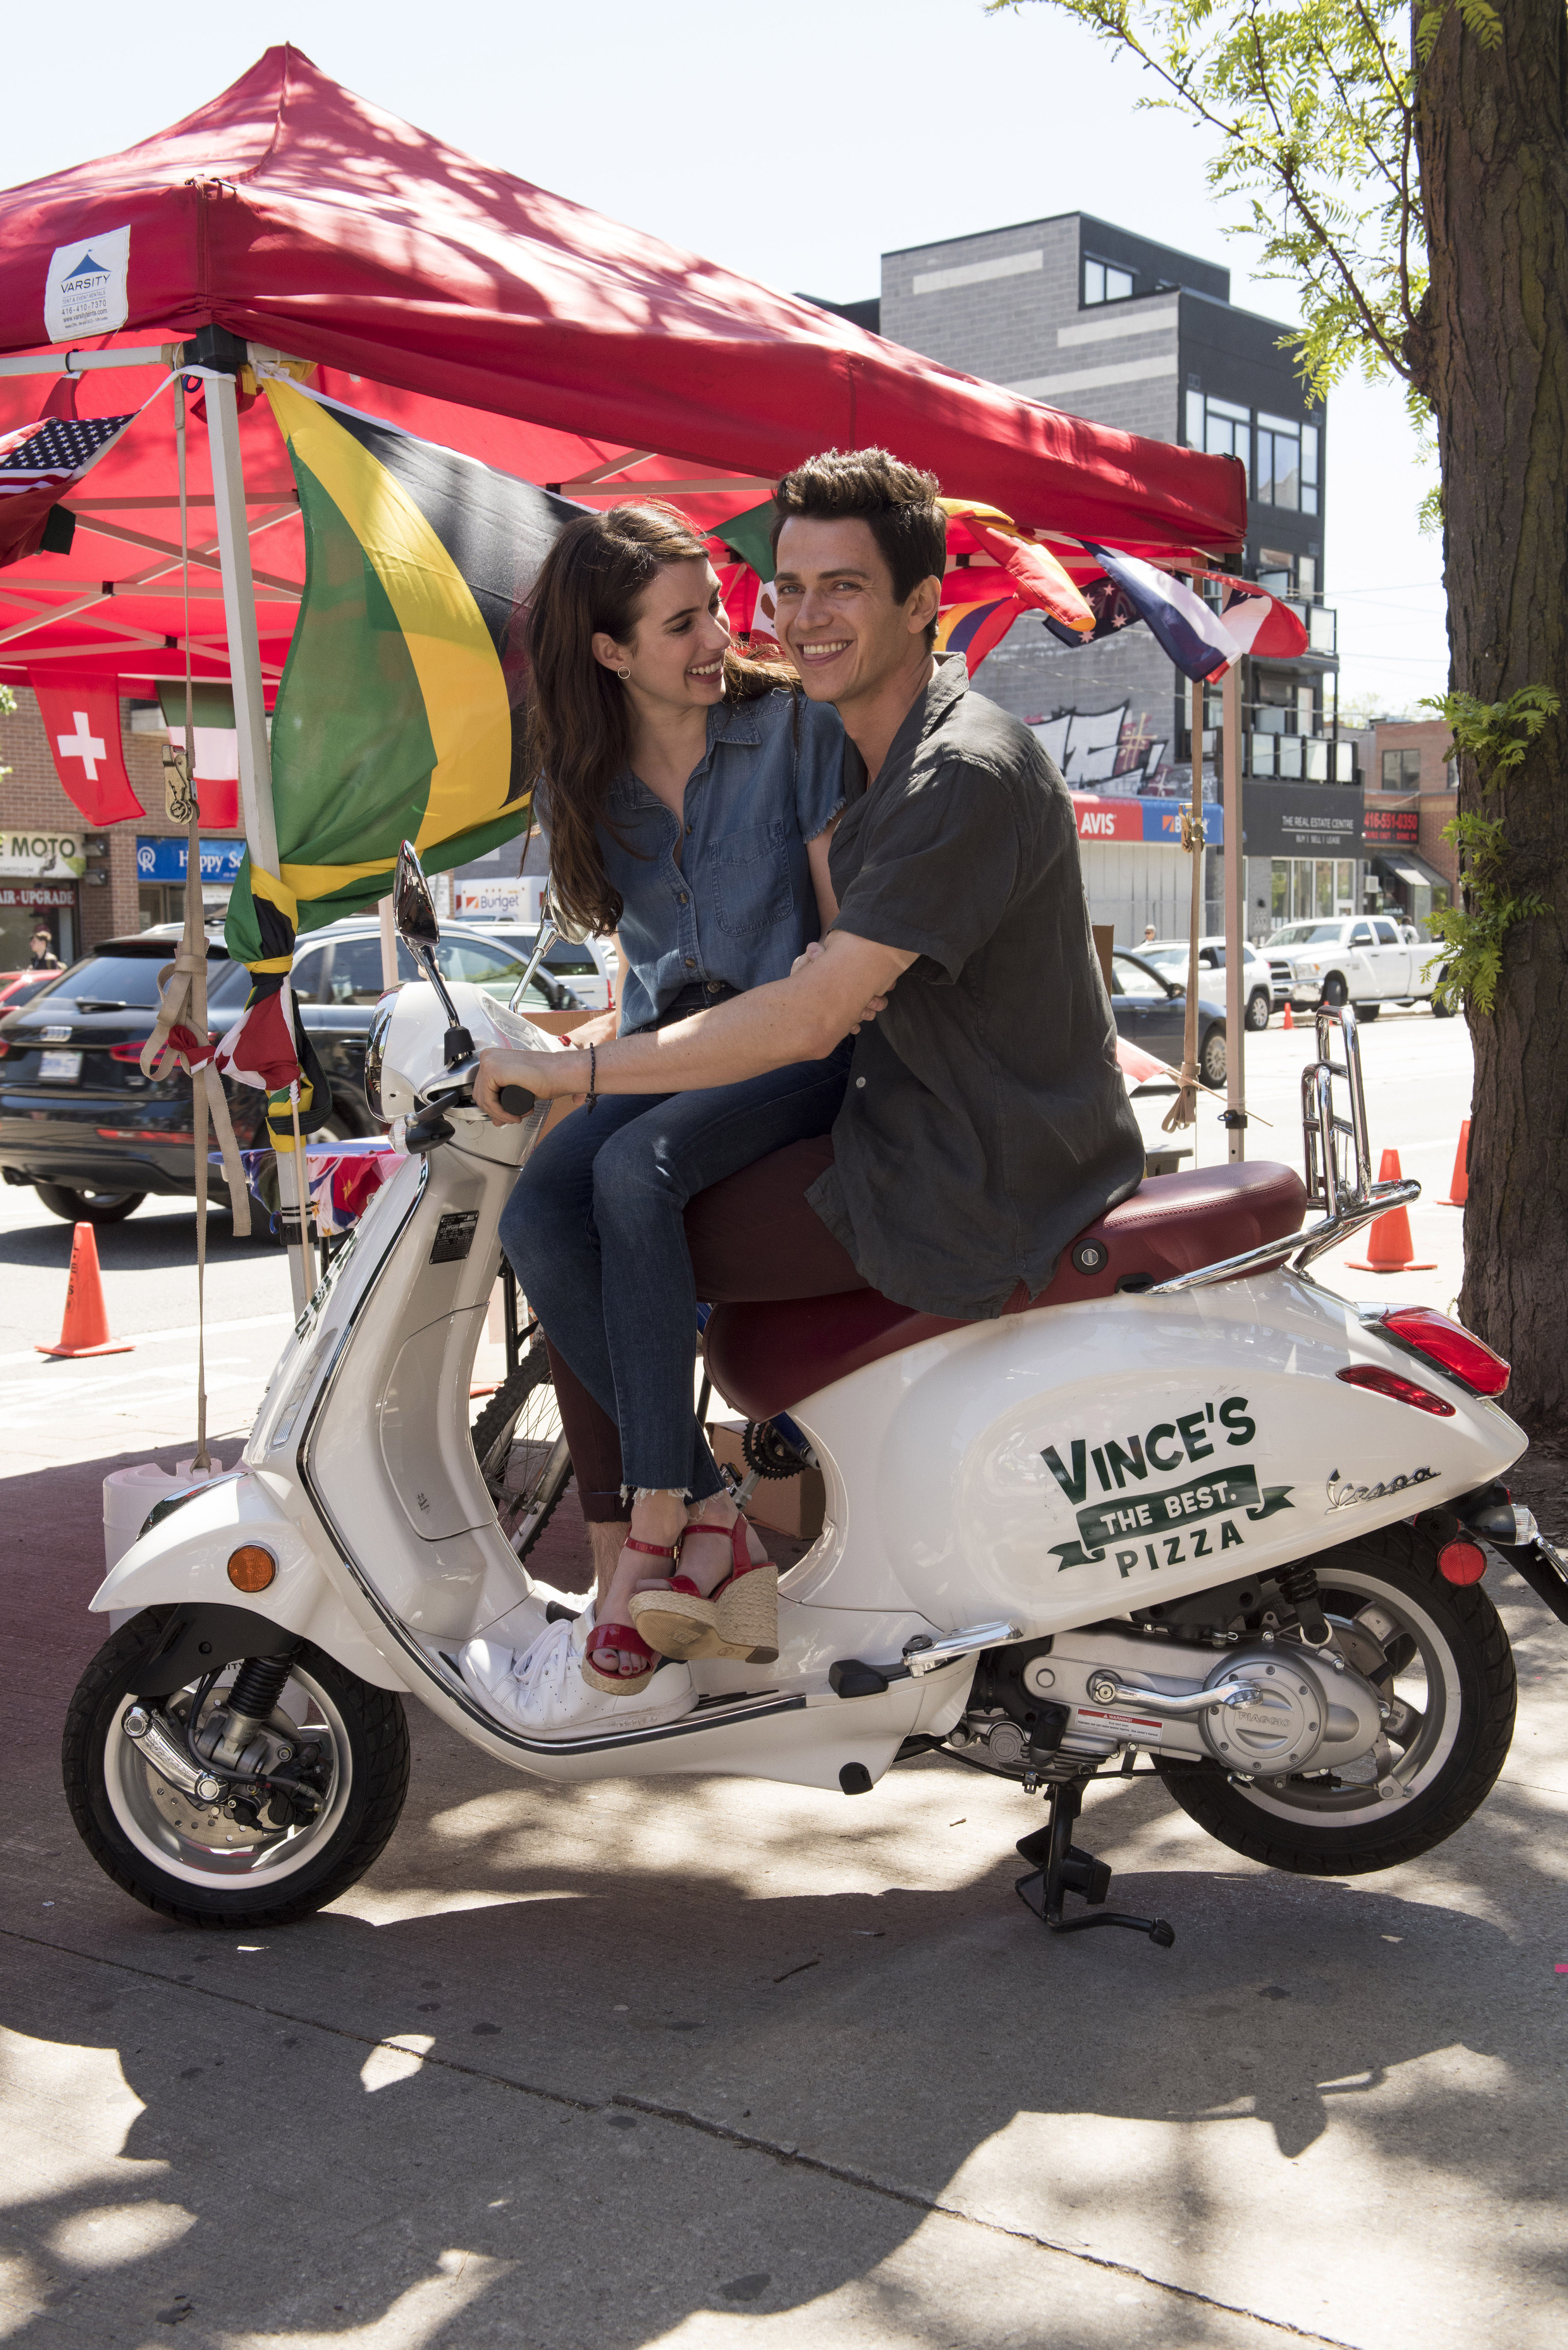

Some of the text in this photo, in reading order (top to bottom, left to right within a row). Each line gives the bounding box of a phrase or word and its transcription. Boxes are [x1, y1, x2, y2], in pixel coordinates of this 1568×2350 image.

[61, 274, 111, 293] VARSITY
[89, 290, 105, 298] RENTALS
[63, 309, 107, 323] www.varsitytents.com
[1080, 812, 1115, 835] AVIS
[1282, 815, 1354, 830] THE REAL ESTATE CENTRE
[11, 837, 75, 858] MOTO
[179, 850, 223, 872] Hppy
[21, 890, 75, 905] UPGRADE
[481, 895, 519, 911] Budget
[1040, 1396, 1256, 1505] VINCE'S
[1325, 1466, 1441, 1515] Vespa
[1100, 1481, 1237, 1535] THE BEST.
[1115, 1519, 1245, 1579] PIZZA
[1109, 1714, 1132, 1723] WARNING!
[1238, 1711, 1291, 1727] PIAGGIO
